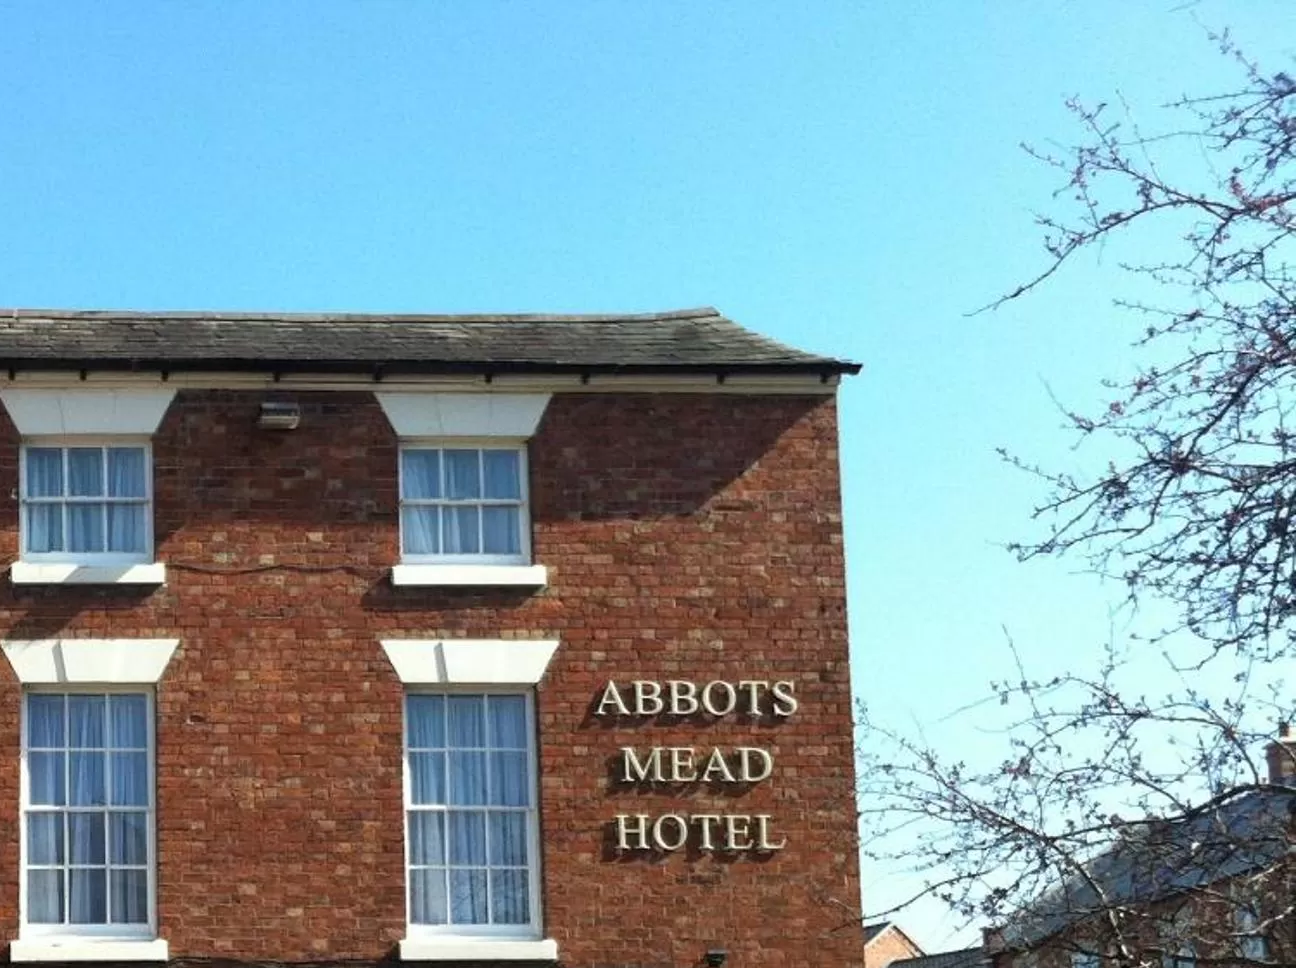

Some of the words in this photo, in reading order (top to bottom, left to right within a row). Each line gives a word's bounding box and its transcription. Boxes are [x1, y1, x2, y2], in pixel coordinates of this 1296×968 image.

[594, 679, 799, 717] ABBOTS
[620, 746, 774, 783] MEAD
[615, 813, 787, 851] HOTEL
